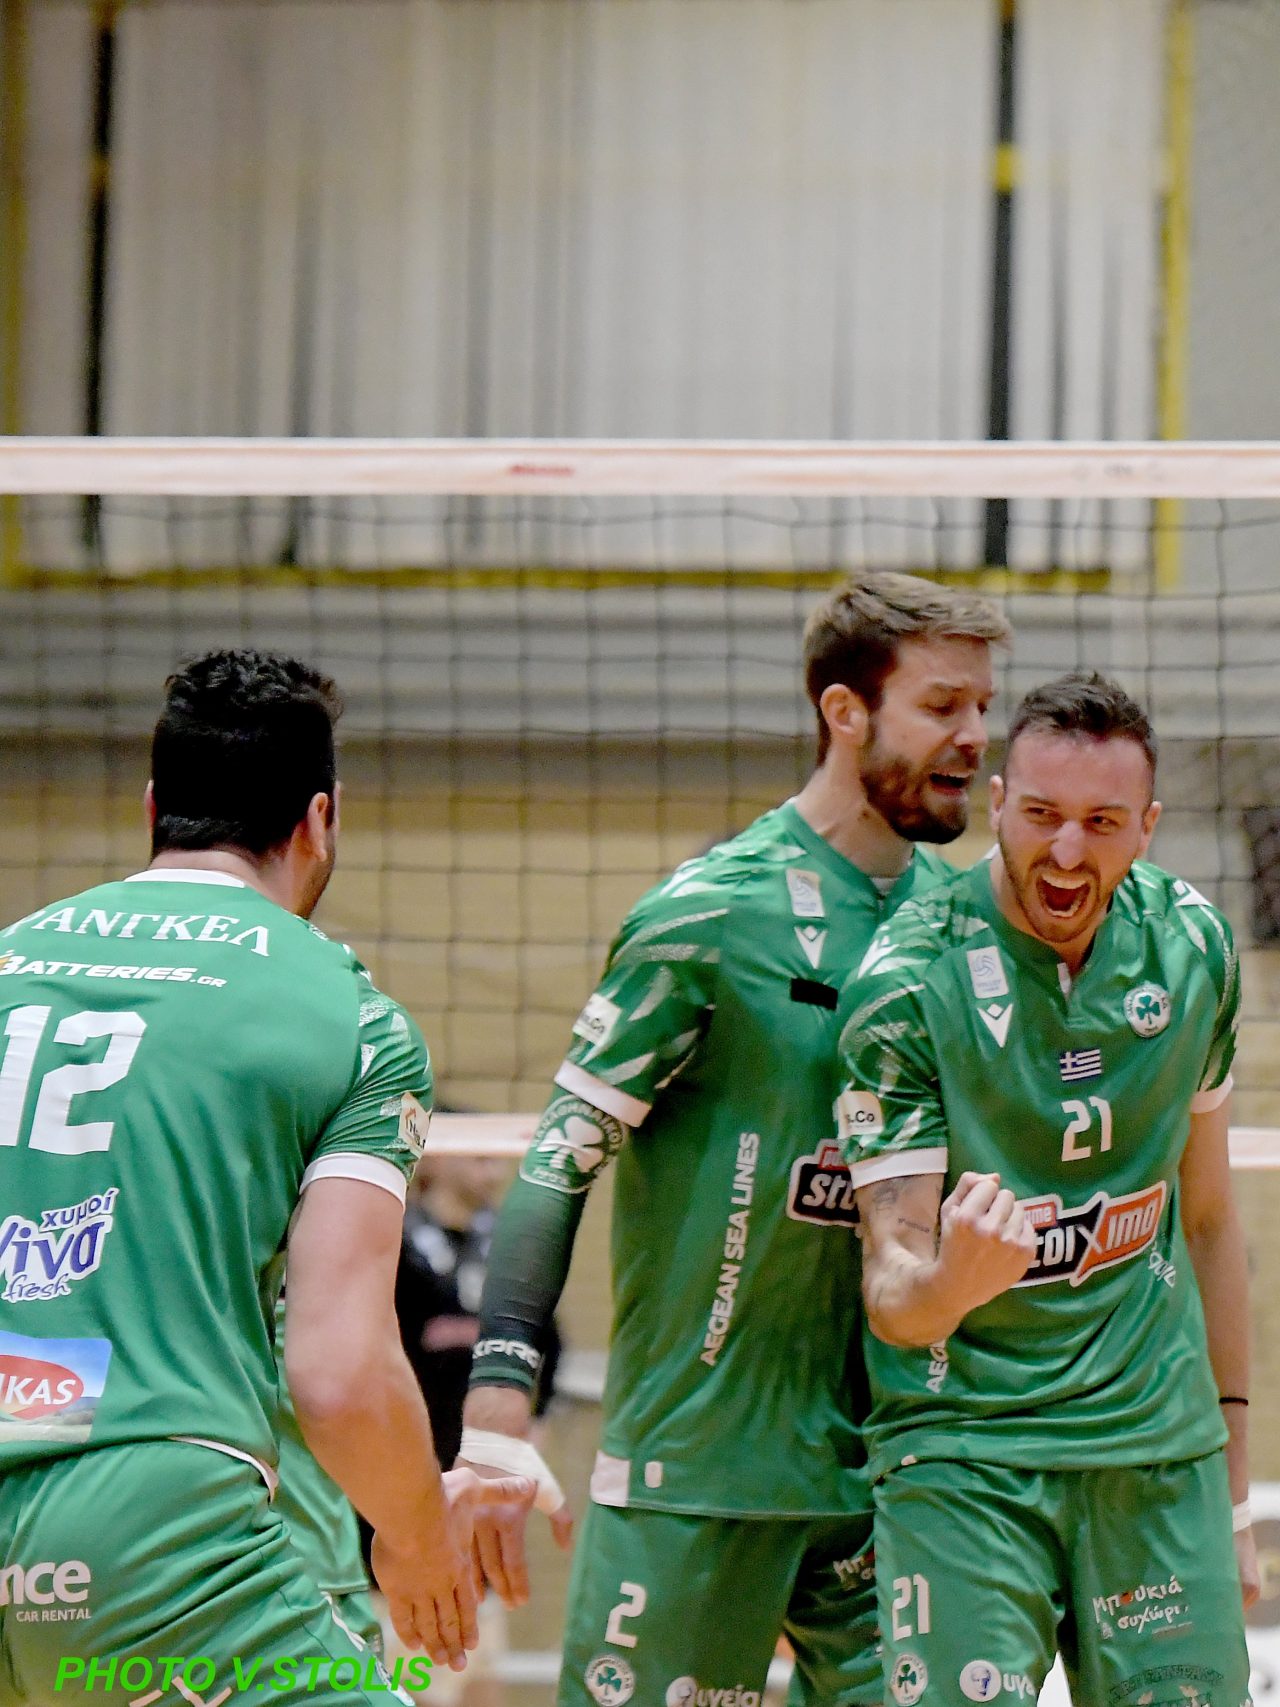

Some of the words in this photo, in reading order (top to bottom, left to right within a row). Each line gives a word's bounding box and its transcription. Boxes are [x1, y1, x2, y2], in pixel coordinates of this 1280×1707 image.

[0, 1005, 147, 1155] 12
[1061, 1096, 1112, 1162] 21
[731, 1132, 760, 1206] LINES
[724, 1210, 751, 1261] SEA
[7, 1274, 70, 1299] fresh
[700, 1263, 742, 1366] AEGEAN
[16, 1610, 39, 1622] CAR
[41, 1608, 92, 1623] RENTAL
[604, 1581, 646, 1648] 2
[892, 1573, 930, 1641] 21
